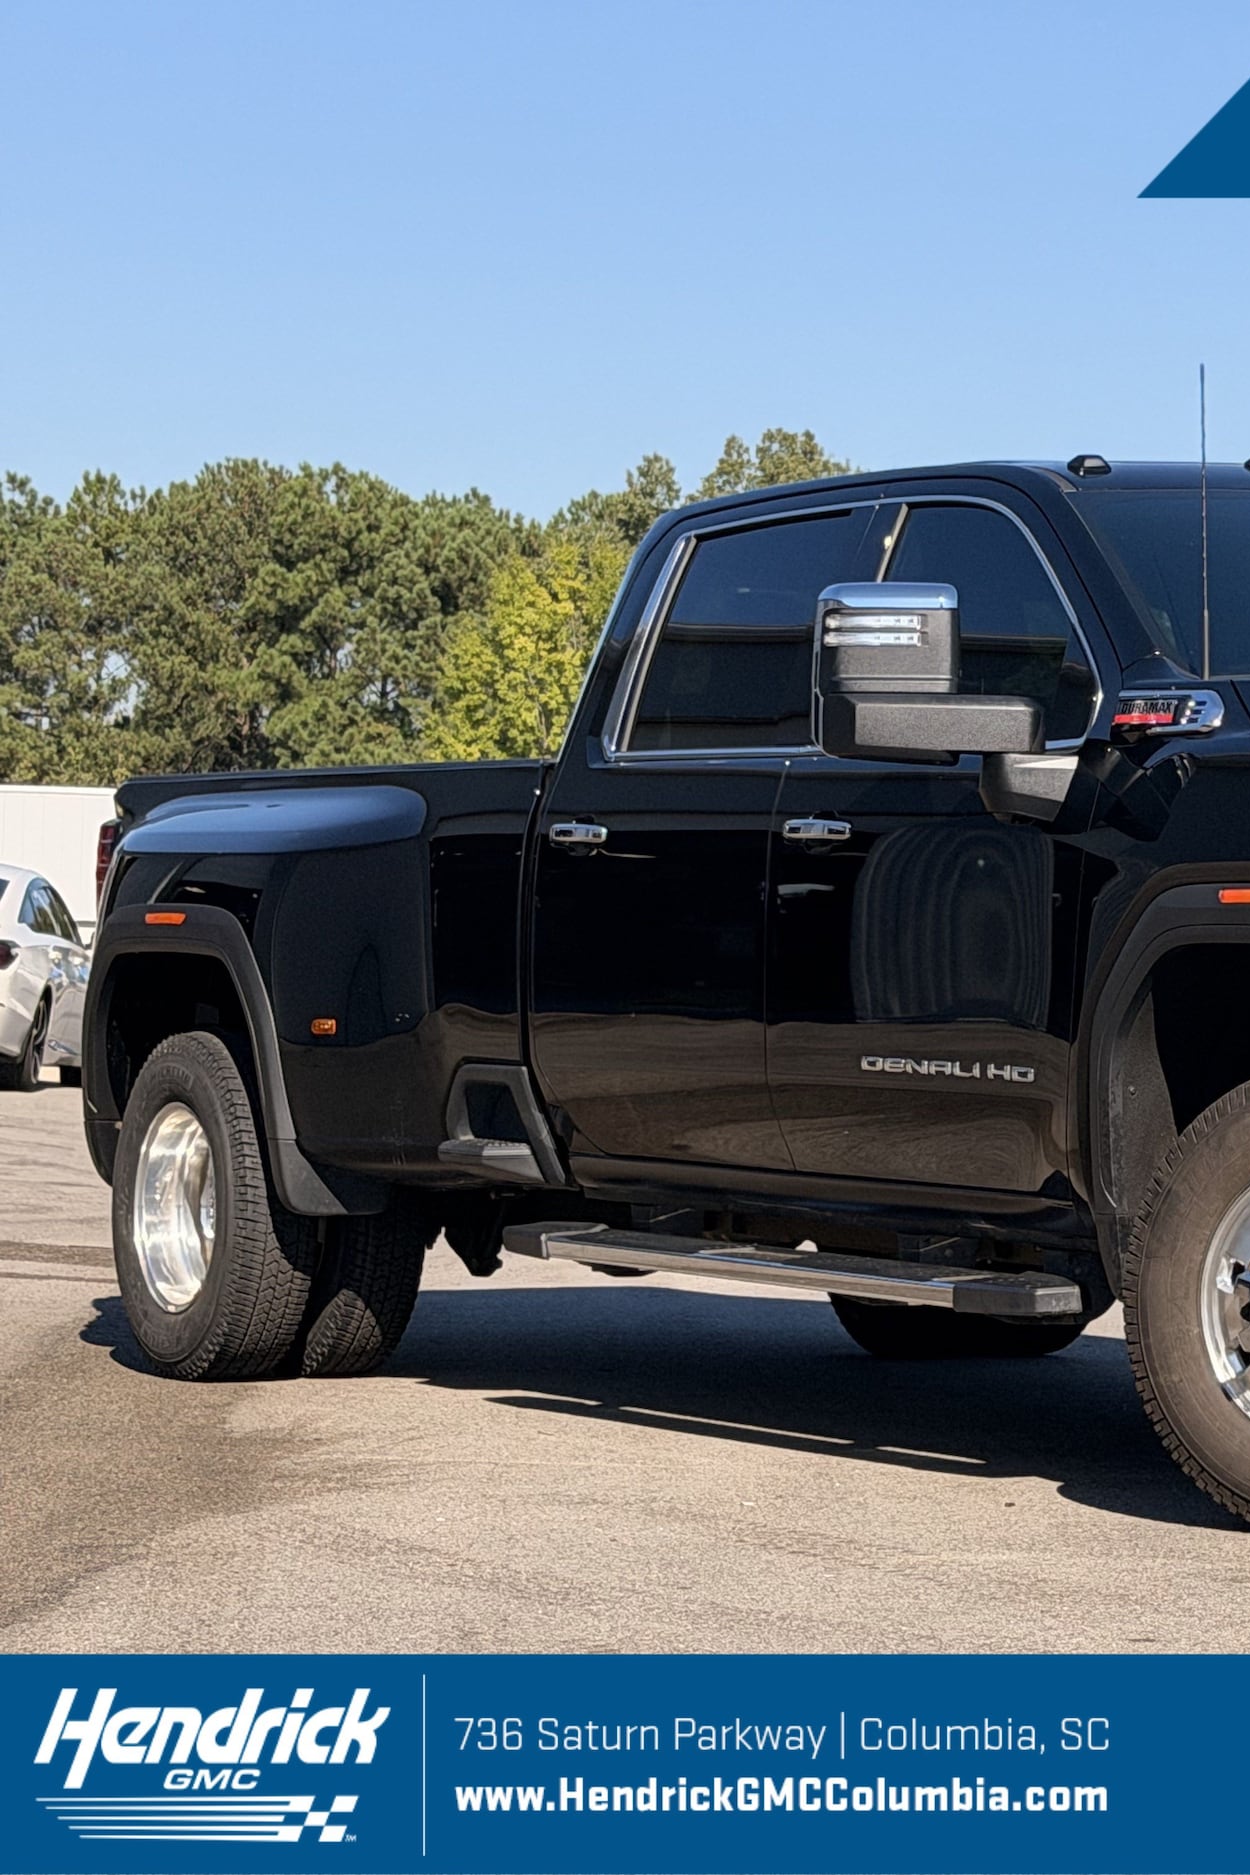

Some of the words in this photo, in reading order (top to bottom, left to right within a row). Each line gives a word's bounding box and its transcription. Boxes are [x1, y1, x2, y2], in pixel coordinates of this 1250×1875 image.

[1120, 700, 1173, 714] DURAMAX
[860, 1056, 981, 1078] DENALI
[986, 1063, 1035, 1082] HD
